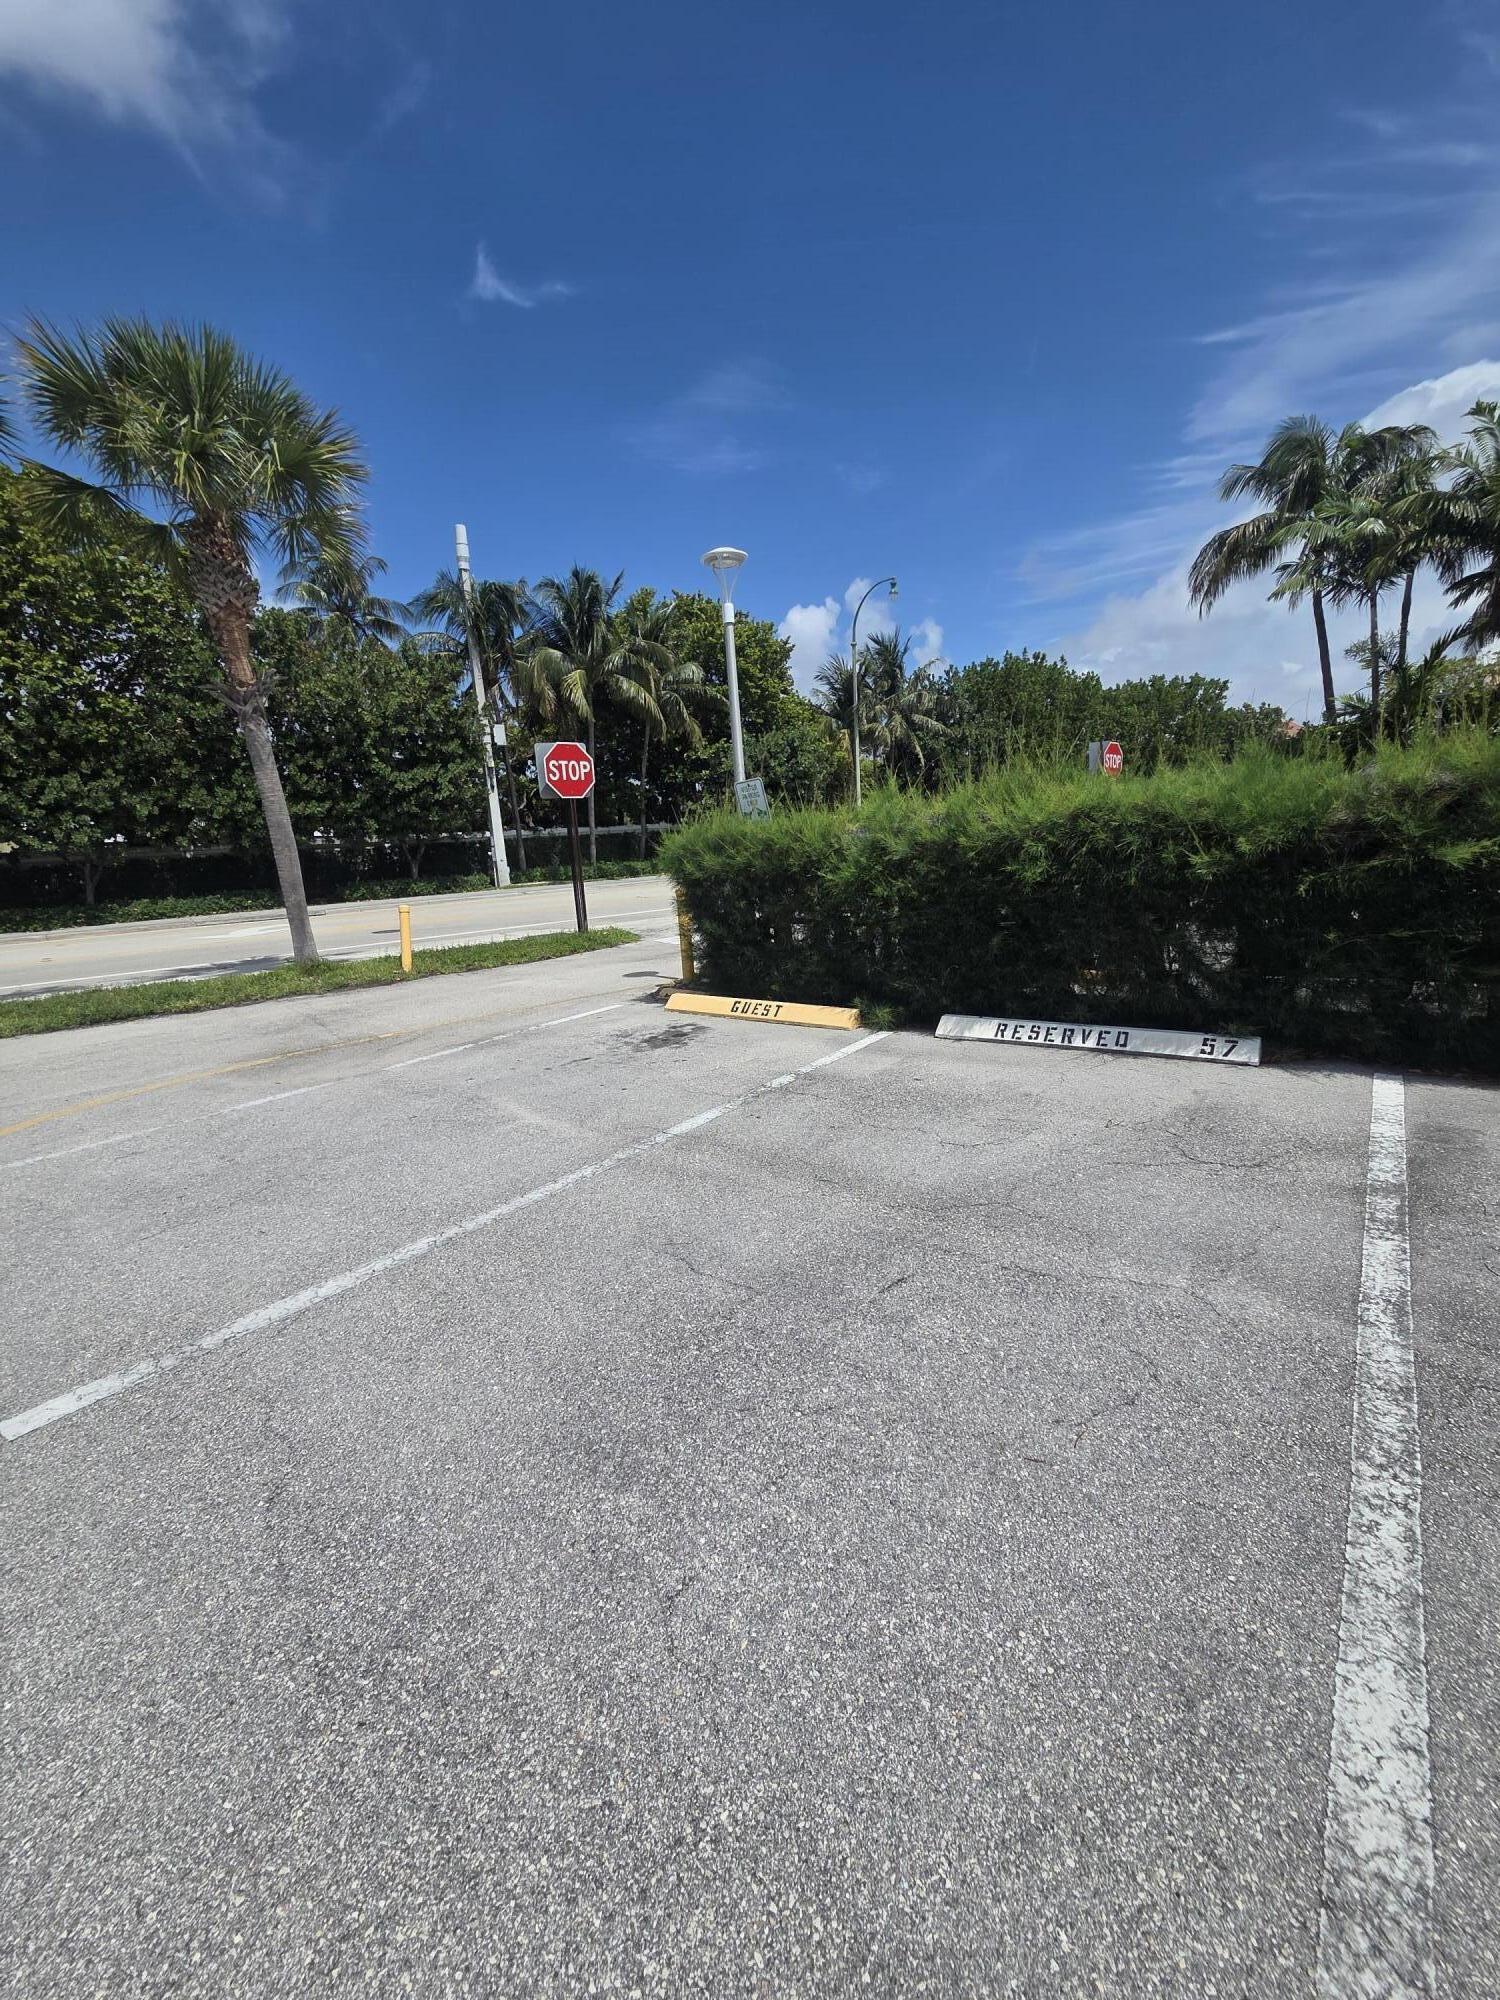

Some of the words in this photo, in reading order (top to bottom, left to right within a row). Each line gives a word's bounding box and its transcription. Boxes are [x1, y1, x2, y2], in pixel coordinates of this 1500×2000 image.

[549, 760, 590, 780] STOP
[1105, 754, 1121, 768] STOP
[730, 1001, 783, 1018] GUEST
[995, 1022, 1129, 1048] RESERVED
[1199, 1037, 1239, 1058] 57
